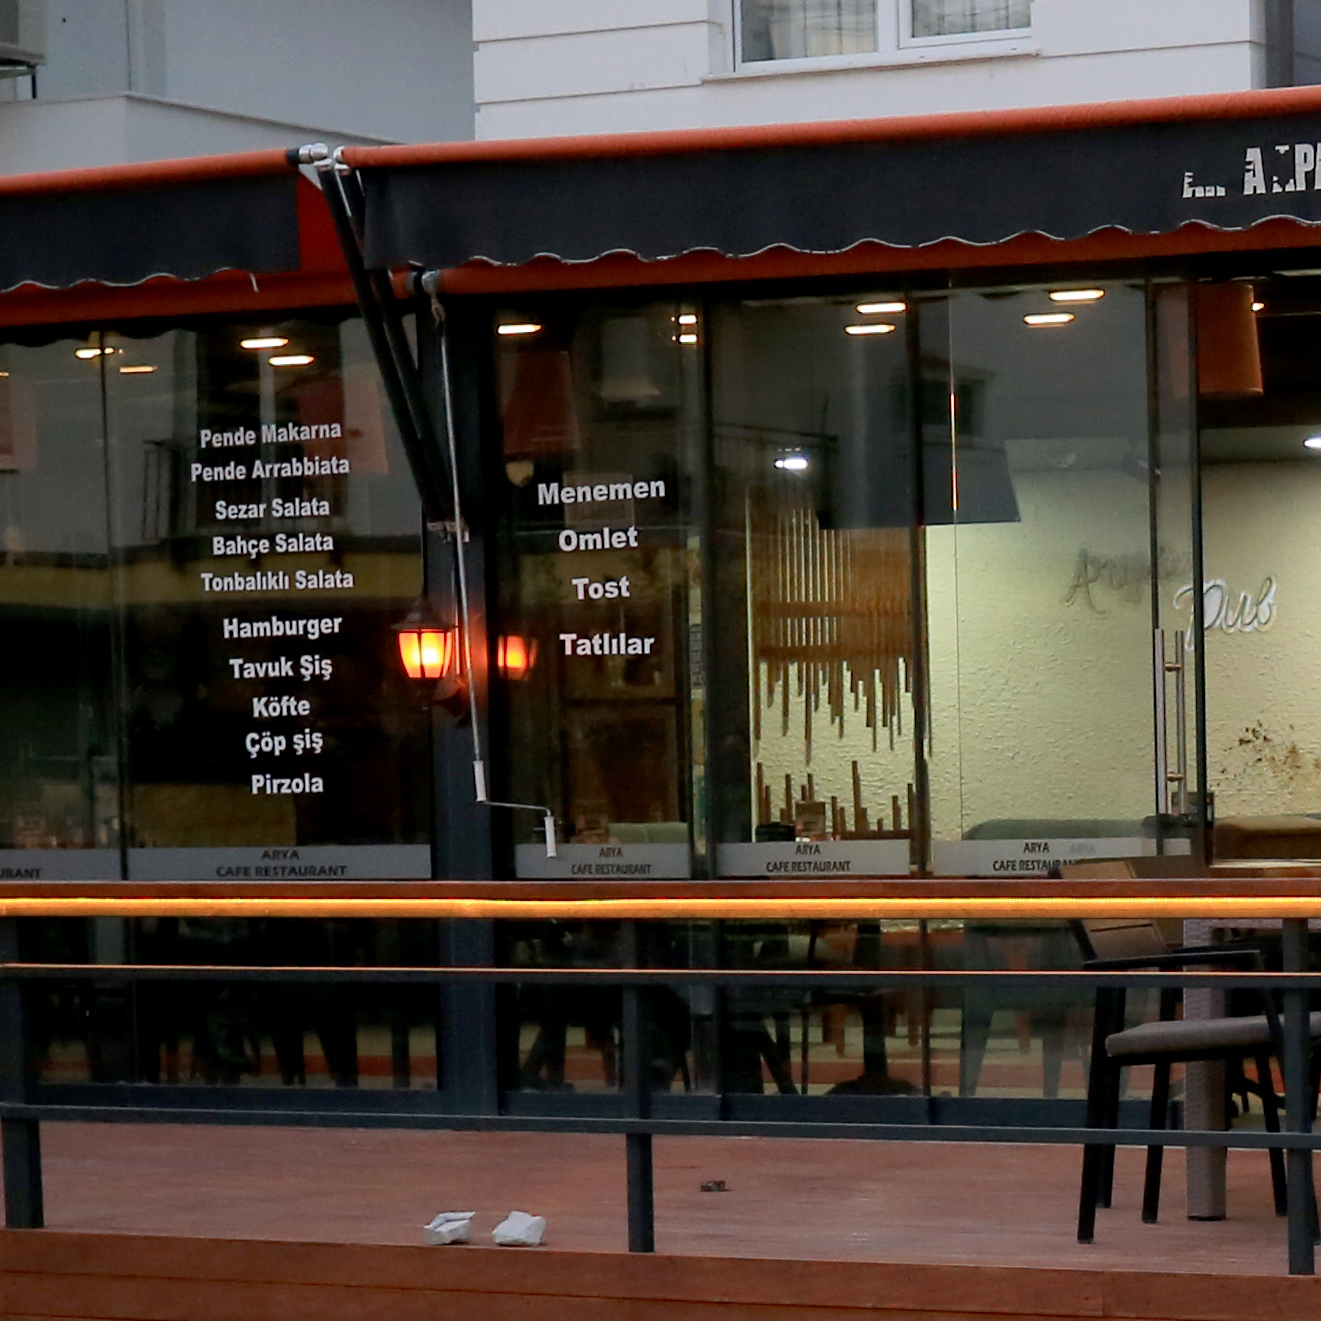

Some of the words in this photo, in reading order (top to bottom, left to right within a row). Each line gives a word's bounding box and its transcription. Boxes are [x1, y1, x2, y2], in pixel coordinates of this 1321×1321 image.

[200, 427, 256, 448] Pende
[261, 422, 342, 443] Makarna
[191, 461, 247, 482] Pende
[252, 456, 350, 479] Arrabbiata
[537, 480, 666, 505] Menemen
[215, 501, 267, 520] Sezar
[271, 498, 330, 518] Salata
[212, 536, 270, 559] Bahçe
[275, 533, 334, 553] Salata
[558, 526, 639, 552] Omlet
[295, 570, 354, 590] Salata
[571, 576, 631, 600] Tost
[223, 616, 343, 640] Hamburger
[229, 656, 294, 679] Tavuk
[300, 655, 333, 681] Şiş
[252, 696, 311, 718] Köfte
[245, 732, 287, 759] Çöp
[292, 728, 324, 755] şiş
[251, 773, 324, 795] Pirzola
[261, 850, 300, 860] ARYA
[1023, 842, 1050, 853] ARYA
[255, 865, 347, 876] RESTAURANT
[992, 860, 1017, 871] CAFE
